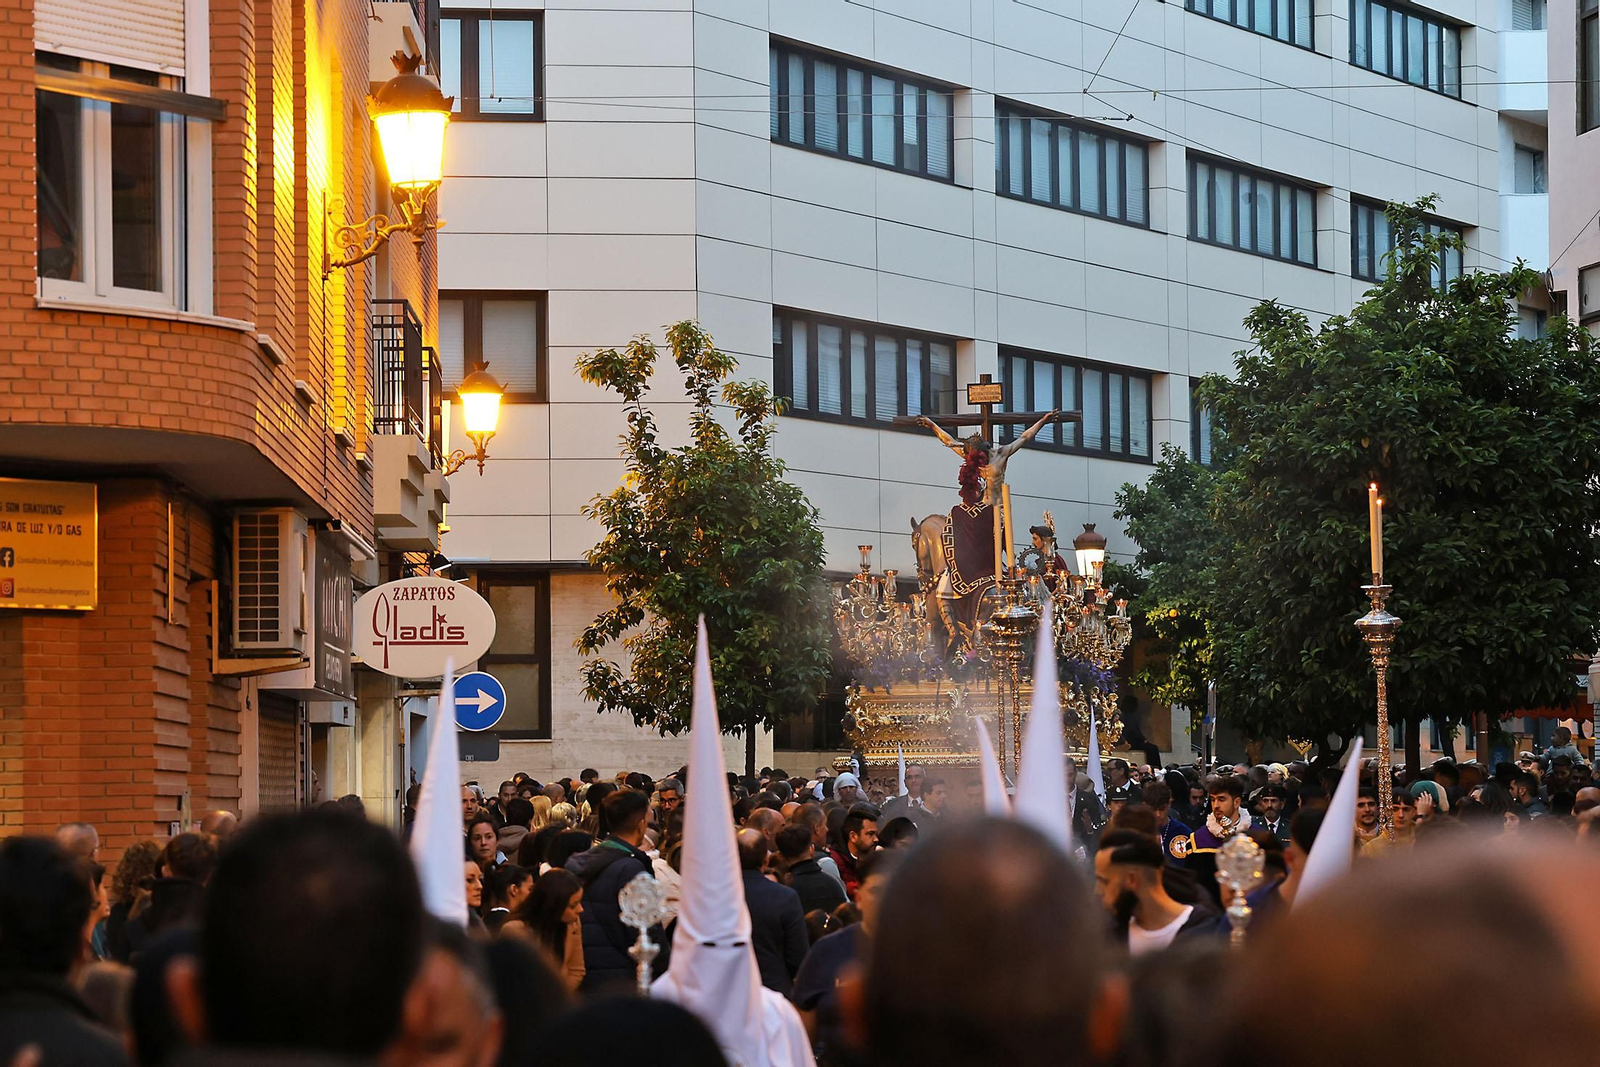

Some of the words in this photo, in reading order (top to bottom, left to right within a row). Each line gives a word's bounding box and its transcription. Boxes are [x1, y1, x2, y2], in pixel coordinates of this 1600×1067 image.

[6, 502, 20, 513] SON
[0, 521, 12, 533] RA
[17, 521, 26, 533] DE
[30, 523, 44, 534] LUZ
[47, 524, 62, 535] Y/O
[66, 525, 82, 536] GAS
[393, 586, 456, 601] ZAPATOS
